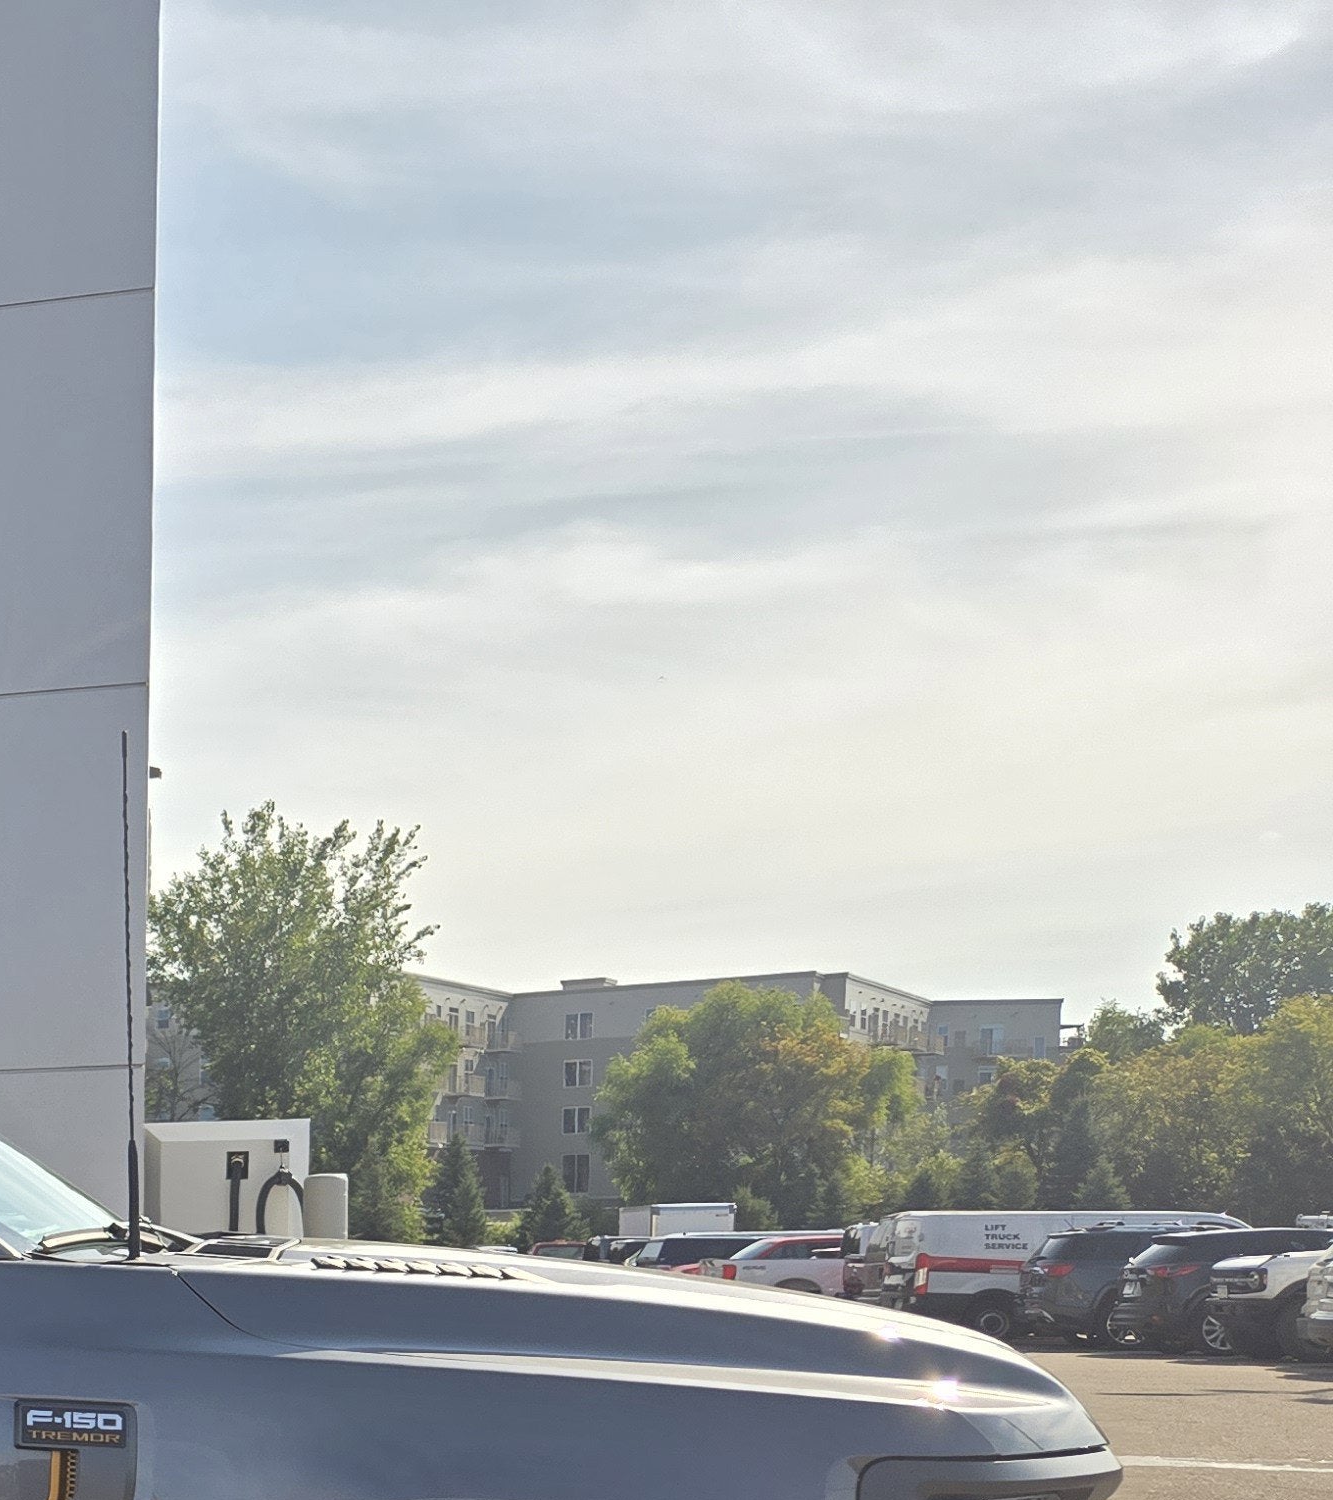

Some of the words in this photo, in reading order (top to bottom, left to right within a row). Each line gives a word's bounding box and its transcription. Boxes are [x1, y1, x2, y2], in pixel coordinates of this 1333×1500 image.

[984, 1224, 1007, 1232] LIFT
[984, 1233, 1021, 1241] TRUCK
[984, 1242, 1029, 1250] SERVICE
[26, 1409, 123, 1430] F-150
[28, 1429, 121, 1443] TREMOR
